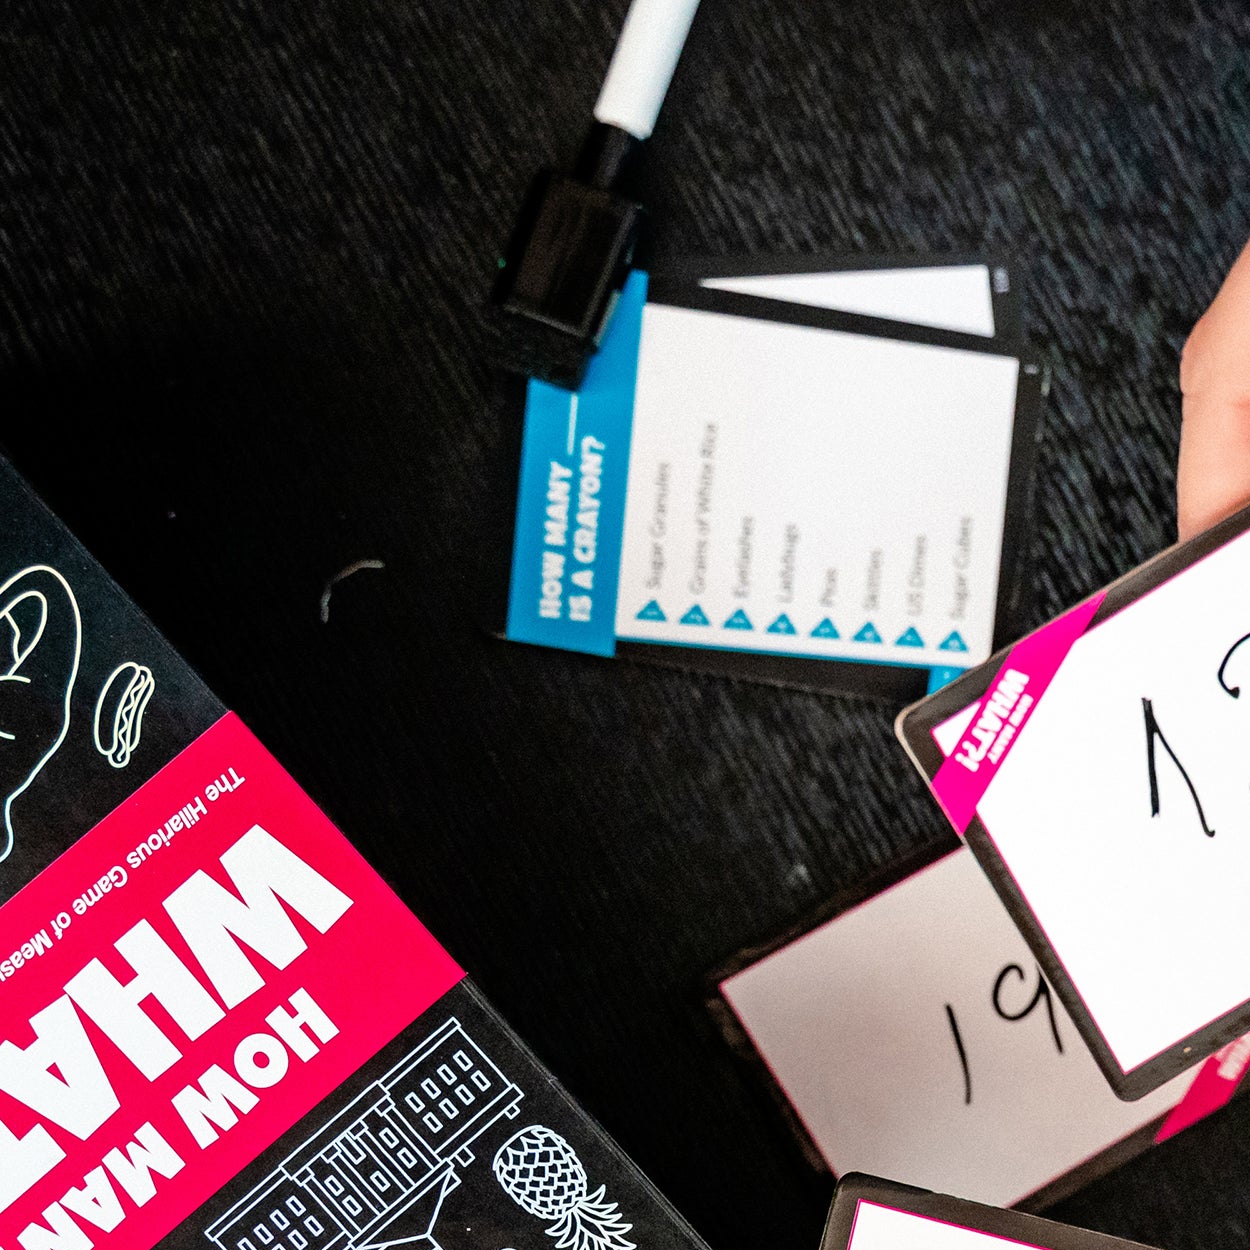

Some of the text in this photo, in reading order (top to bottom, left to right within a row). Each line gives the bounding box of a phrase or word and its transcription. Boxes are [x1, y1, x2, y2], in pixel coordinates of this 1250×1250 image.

[539, 461, 573, 618] HOW MANY
[569, 435, 606, 622] IS A CRAYON?
[955, 668, 1030, 772] WHAT?!
[126, 796, 208, 869] Hilarious
[205, 767, 246, 801] The
[50, 912, 71, 940] of
[72, 866, 128, 915] Game
[171, 986, 341, 1150] HOW
[945, 962, 1065, 1105] 19
